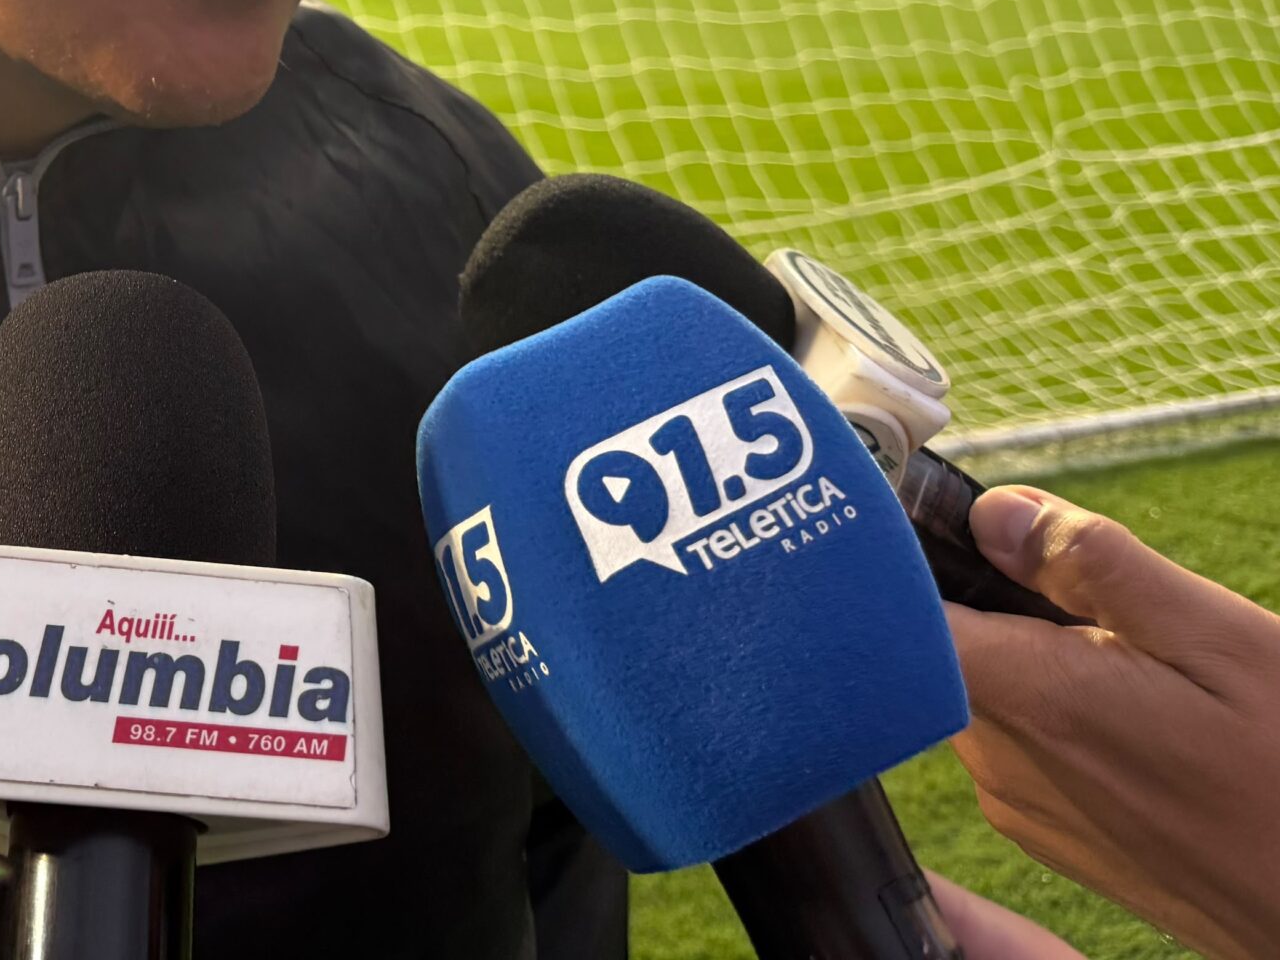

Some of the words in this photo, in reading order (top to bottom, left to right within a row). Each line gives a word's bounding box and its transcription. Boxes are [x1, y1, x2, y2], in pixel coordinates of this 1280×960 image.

[577, 378, 805, 544] 91.5
[781, 505, 857, 554] RADIO
[440, 520, 507, 640] 1.5
[129, 724, 177, 744] 98.7
[185, 729, 218, 746] FM
[247, 734, 286, 753] 760
[293, 738, 328, 756] AM
